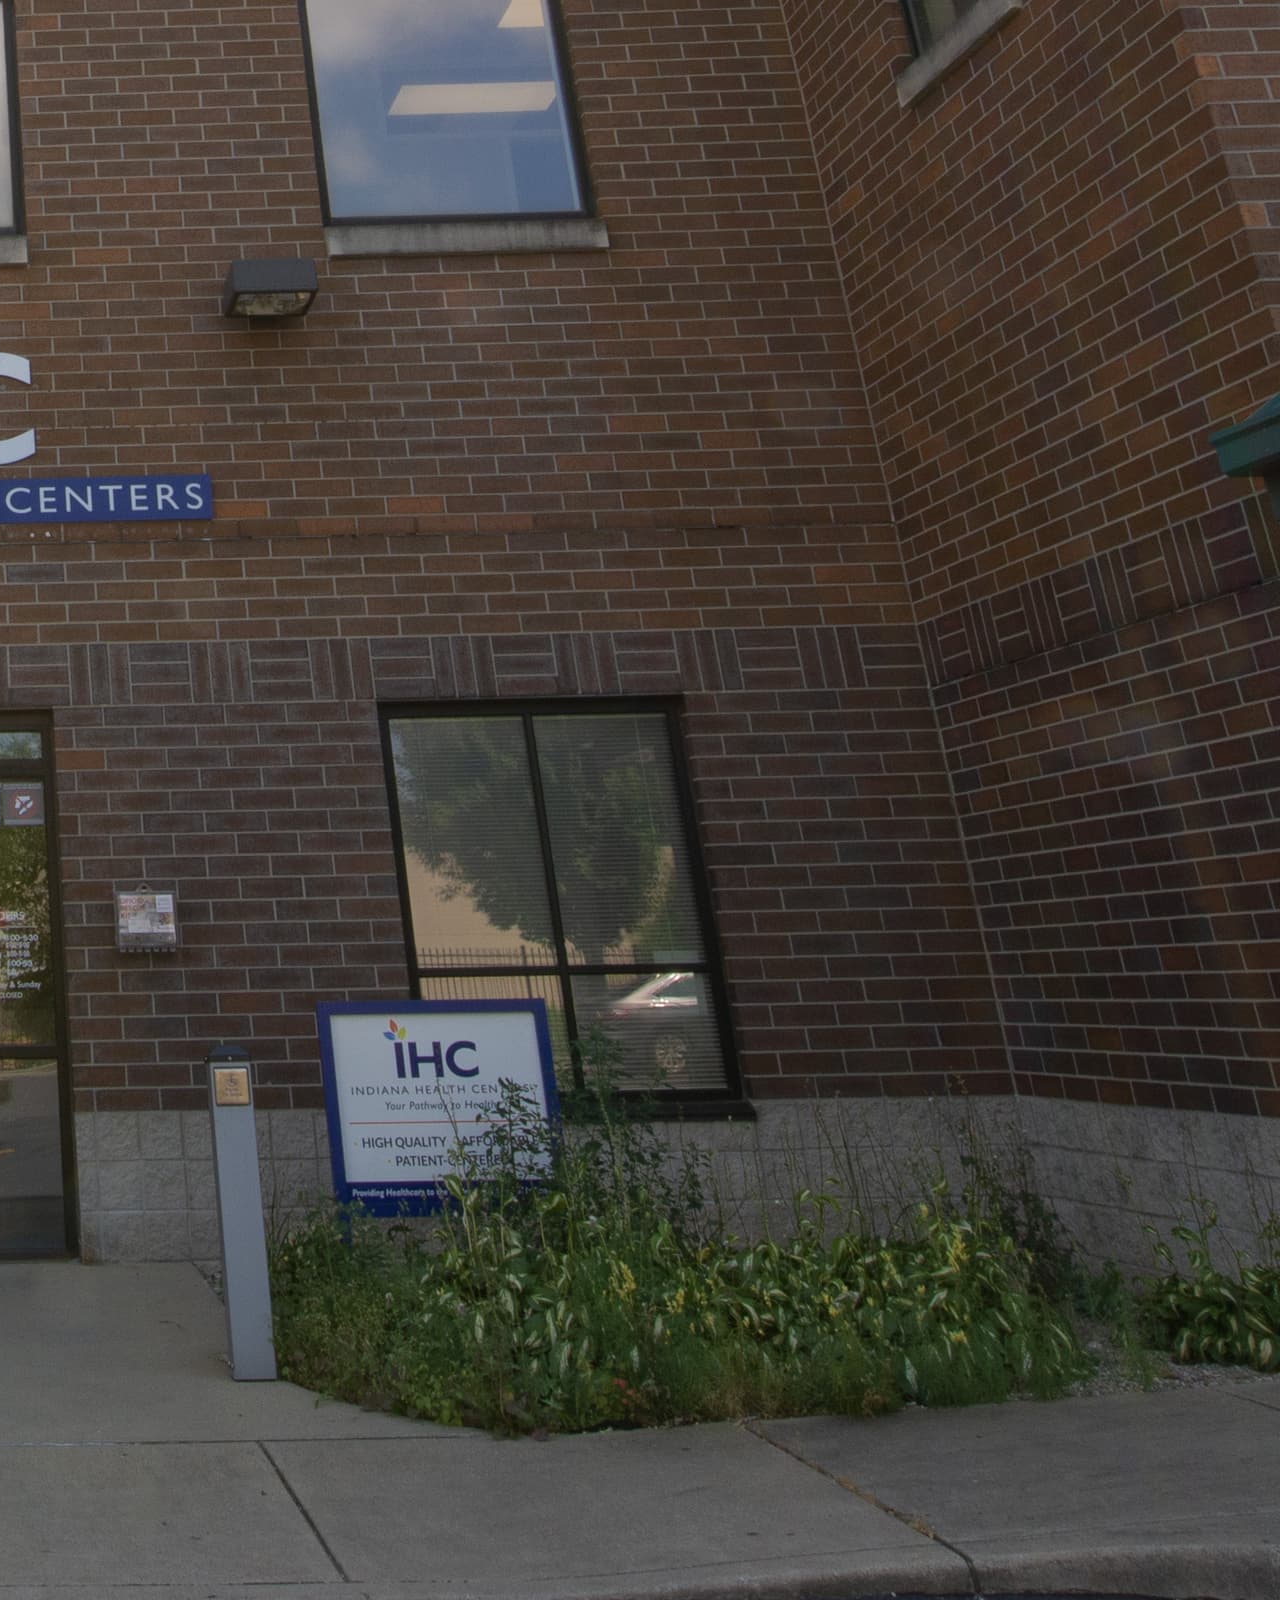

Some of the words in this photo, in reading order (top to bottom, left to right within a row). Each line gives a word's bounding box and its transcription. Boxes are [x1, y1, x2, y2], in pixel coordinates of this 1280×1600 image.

[5, 483, 204, 514] CENTERS
[394, 1040, 480, 1078] IHC
[351, 1085, 410, 1096] INDIANA
[415, 1084, 466, 1095] HEALTH
[385, 1101, 406, 1111] Your
[409, 1100, 448, 1113] Pathway
[451, 1100, 461, 1110] to
[362, 1137, 392, 1148] HIGH
[395, 1136, 447, 1149] QUALITY
[352, 1188, 384, 1199] Providing
